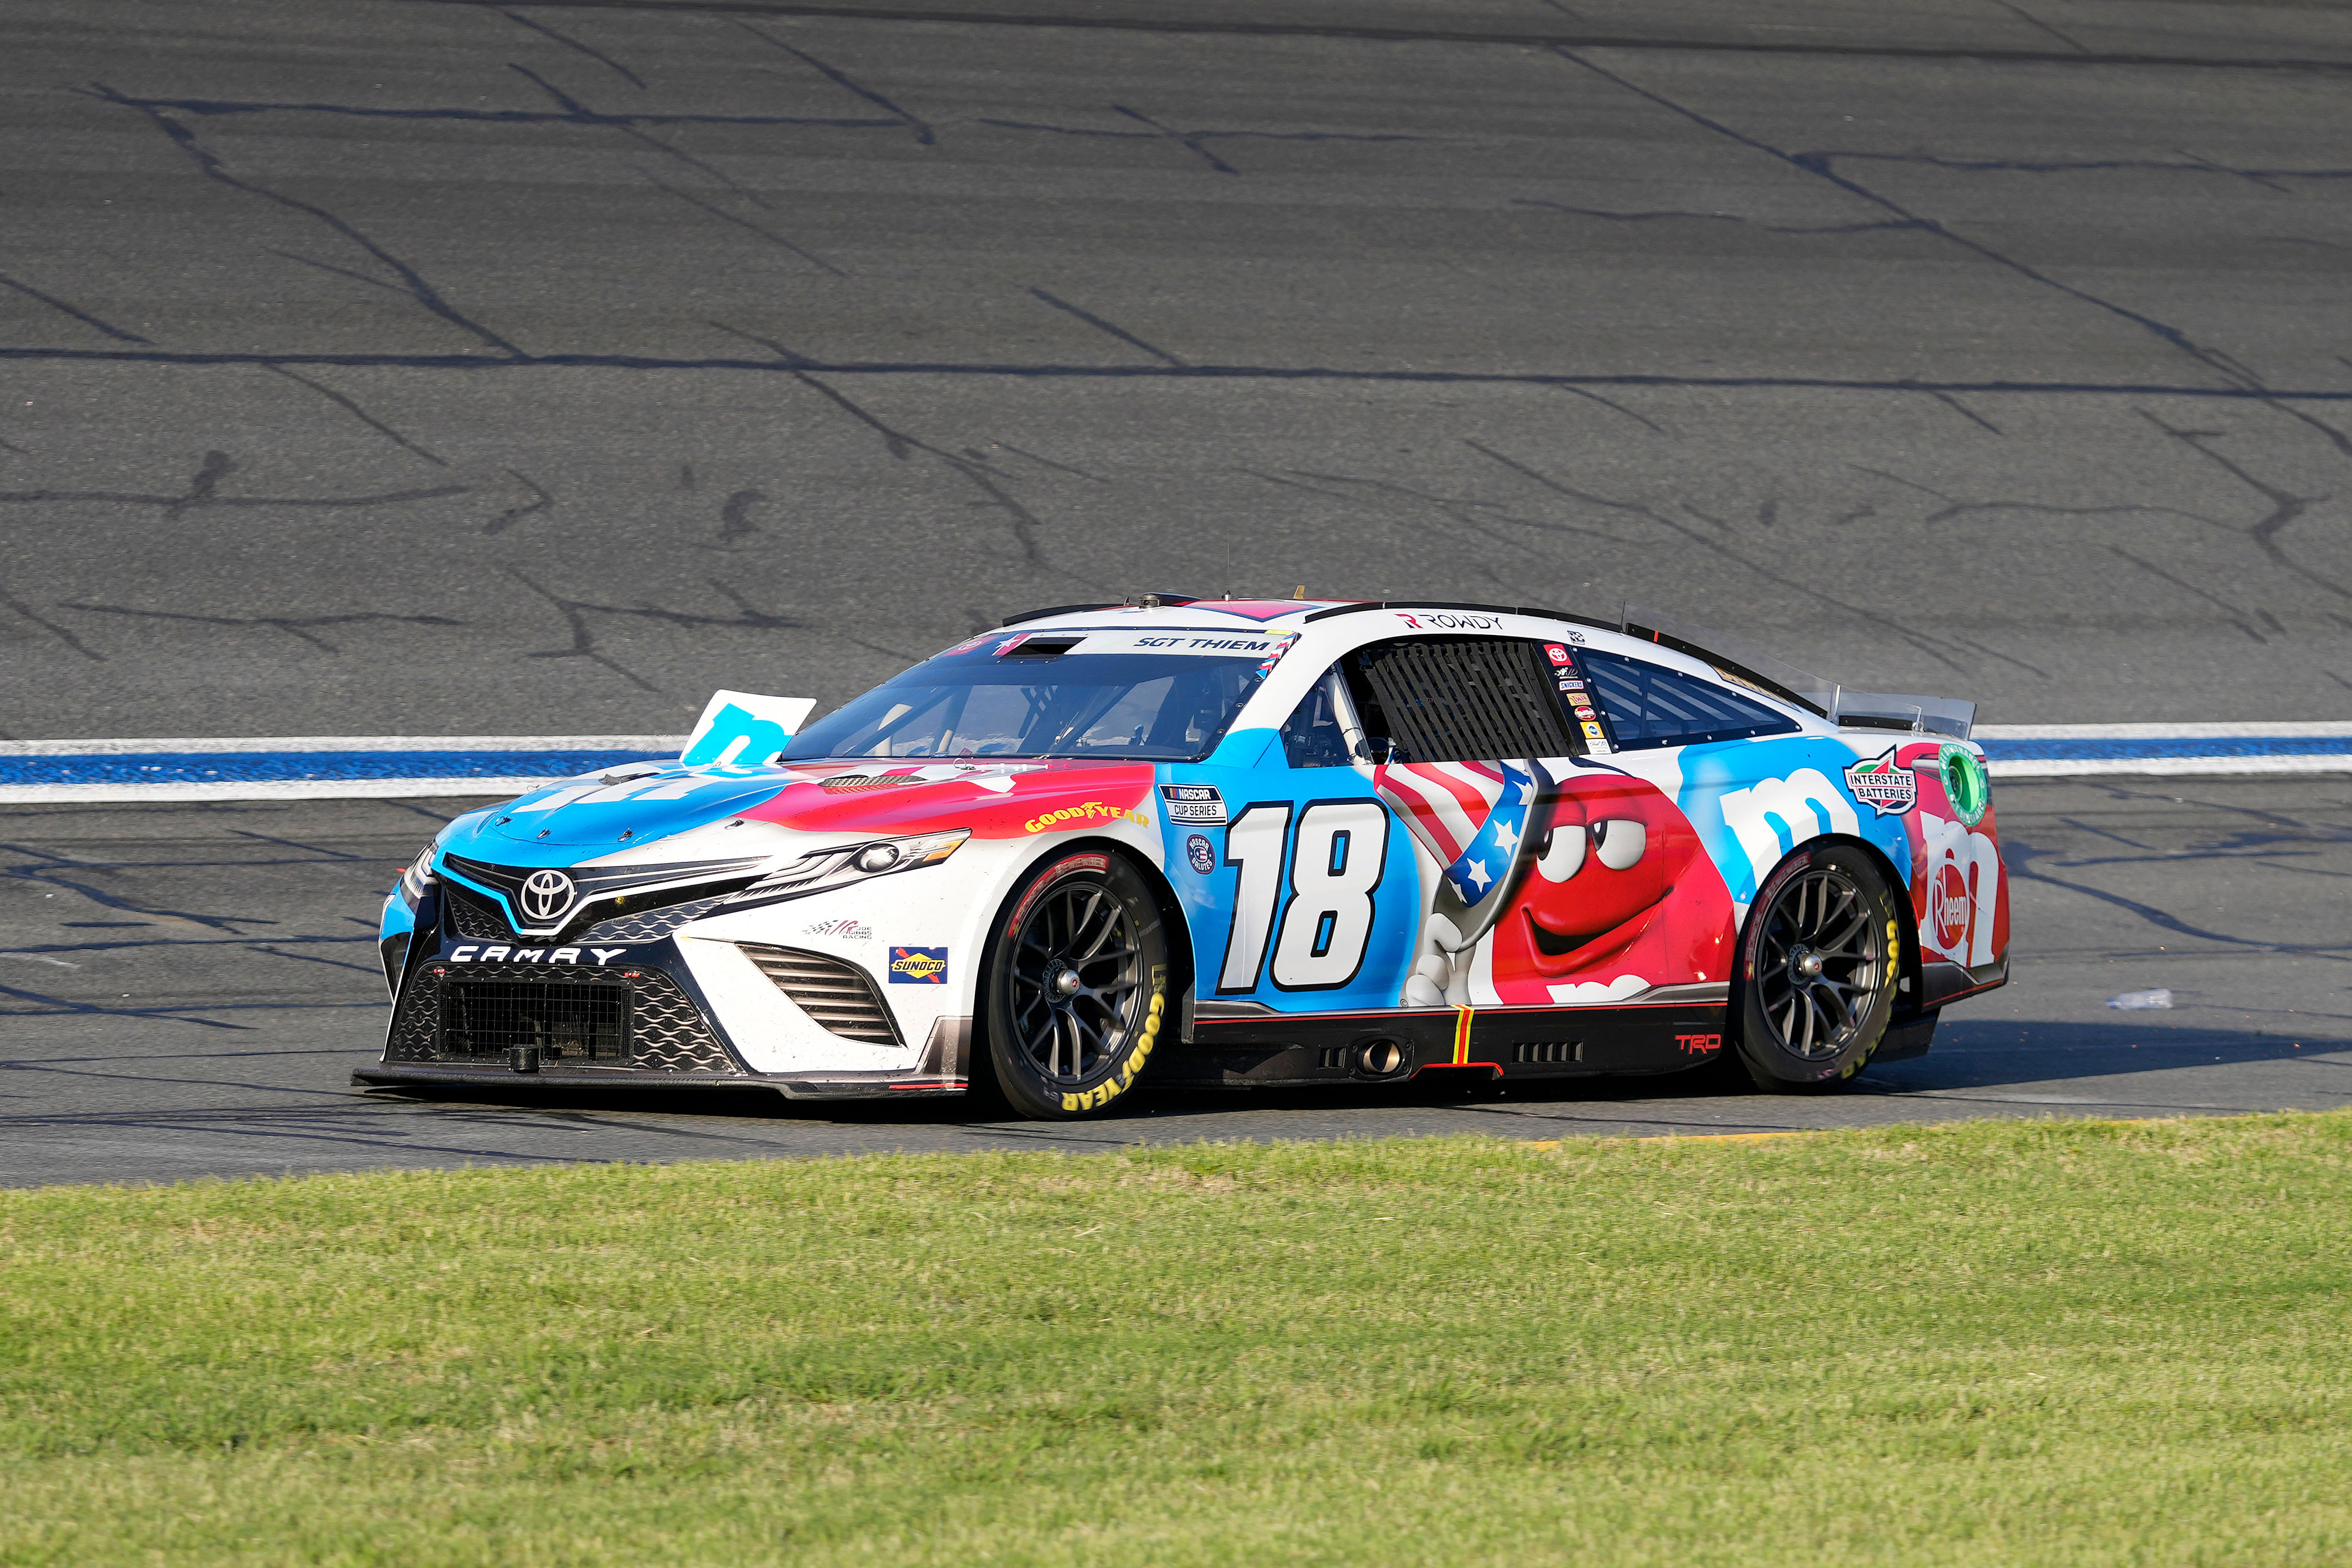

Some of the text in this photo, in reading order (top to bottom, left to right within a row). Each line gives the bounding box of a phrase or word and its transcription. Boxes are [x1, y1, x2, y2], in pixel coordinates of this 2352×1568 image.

[1418, 614, 1503, 630] ROWDY
[1133, 637, 1271, 651] SGT THIEM
[1850, 774, 1911, 786] INTERSTATE
[1178, 788, 1211, 800] NASCAR
[1859, 788, 1912, 800] BATTERIES
[1174, 804, 1217, 816] CUP SERIES
[1025, 802, 1150, 834] GOODYEAR
[1189, 838, 1210, 851] NASCAR
[1191, 857, 1213, 871] SALUTES
[1215, 796, 1391, 996] 18
[1934, 864, 1967, 938] Rheem
[894, 961, 944, 971] SUNOCO
[1675, 1034, 1721, 1054] TRD
[1061, 992, 1165, 1112] GOODYEAR
